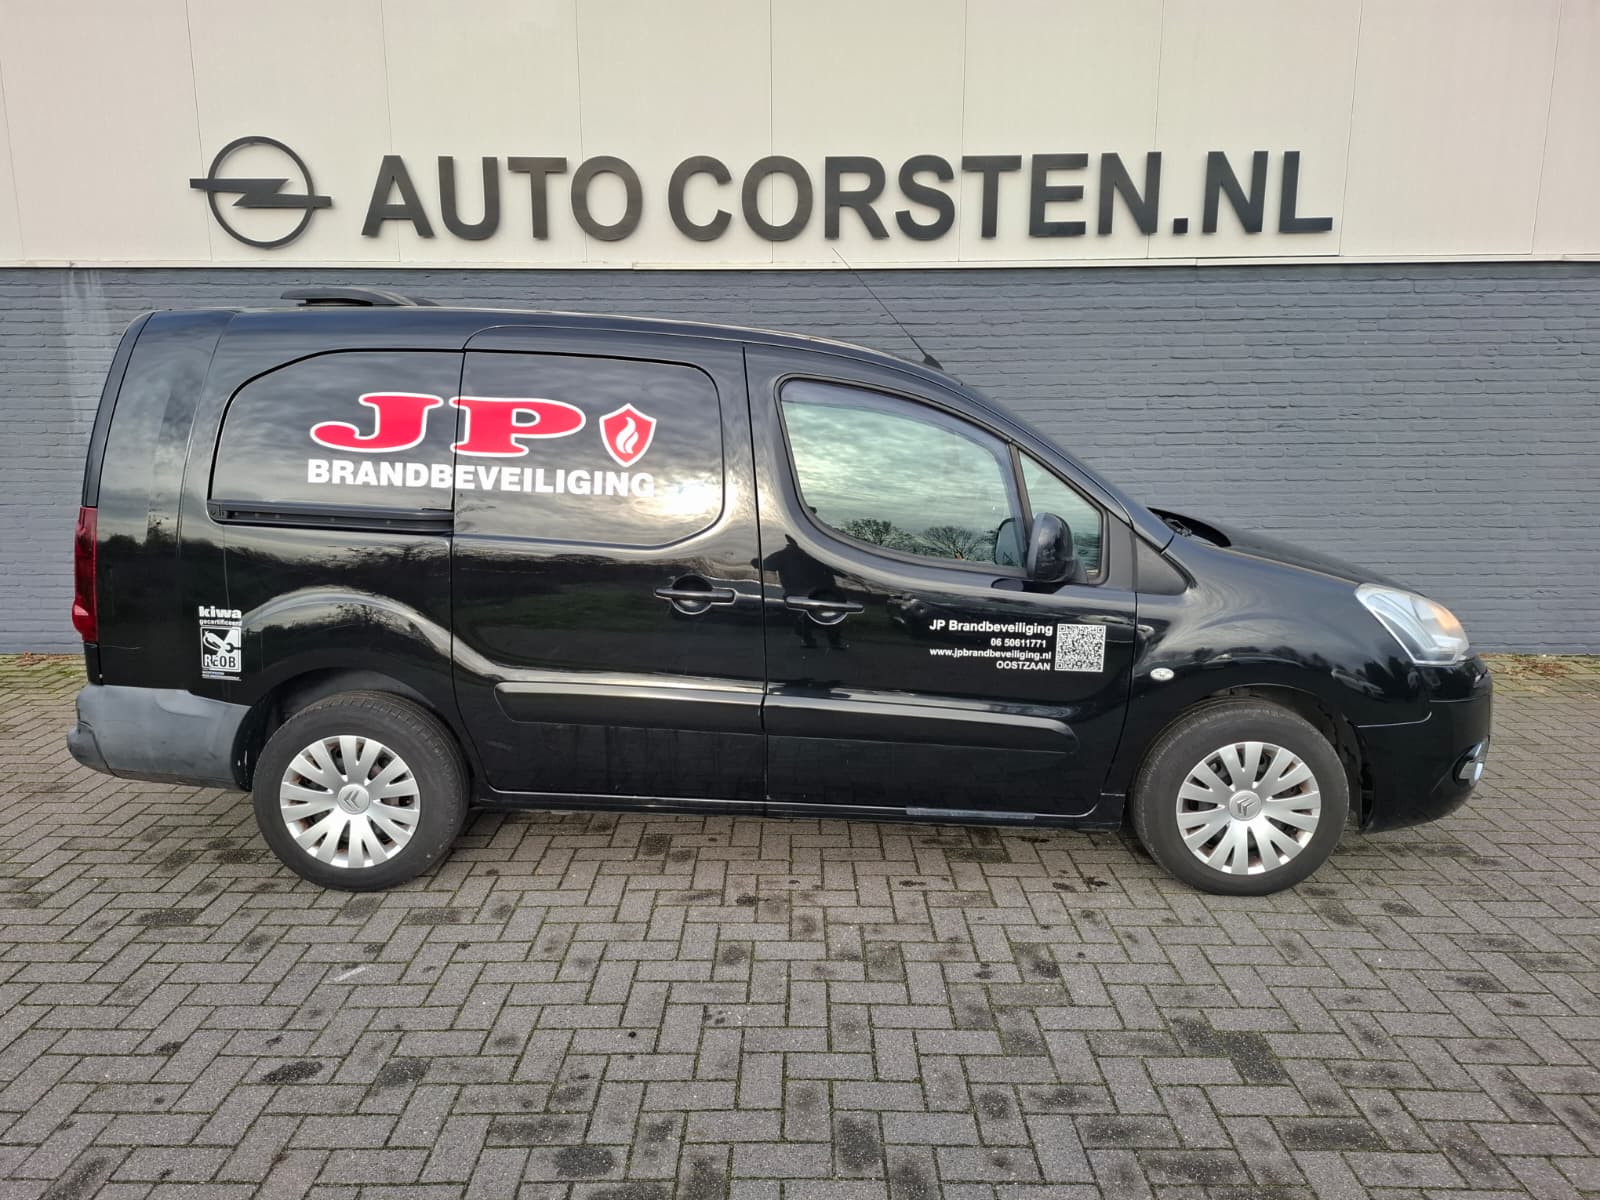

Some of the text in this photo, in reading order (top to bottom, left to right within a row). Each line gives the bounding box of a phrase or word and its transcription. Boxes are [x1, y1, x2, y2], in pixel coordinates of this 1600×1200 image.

[361, 150, 1334, 242] AUTO CORSTEN.NL
[310, 391, 587, 457] JP
[307, 458, 655, 498] BRANDBEVEILIGING
[198, 605, 242, 619] kiwa
[929, 619, 1053, 635] JP Brandbeveiliging
[990, 637, 1046, 648] 06 50611771
[204, 654, 235, 667] REOB
[929, 648, 1051, 660] www.jpbrandbeveiliging.nl
[996, 660, 1051, 671] OOSTZAAN
